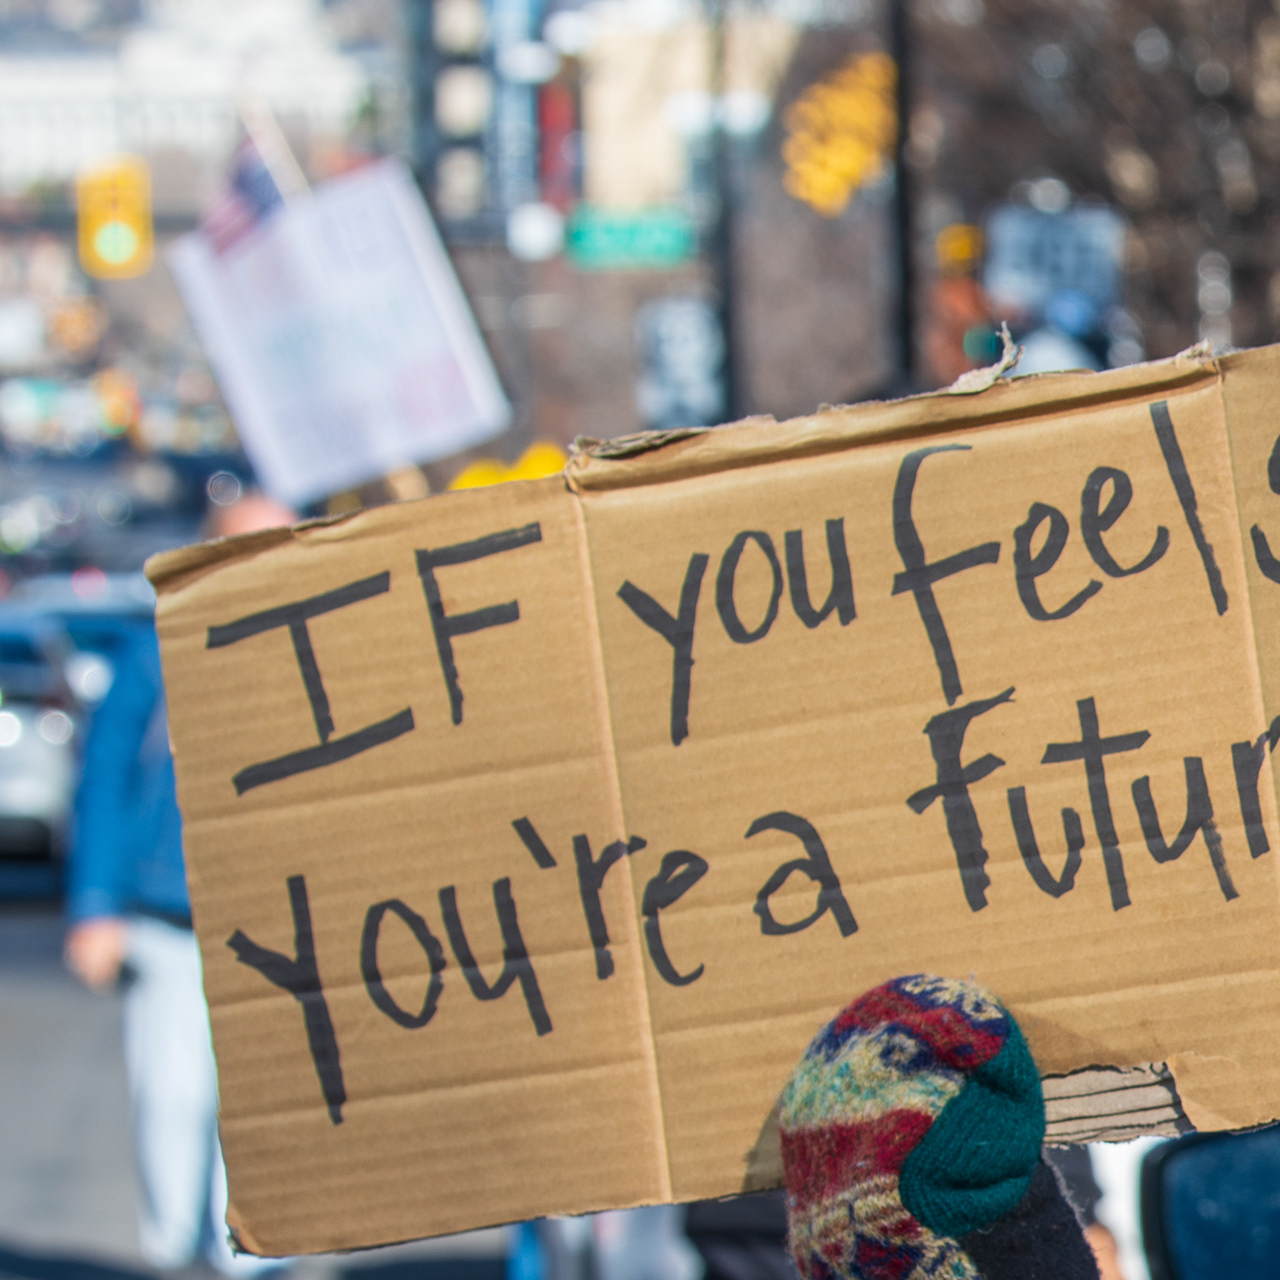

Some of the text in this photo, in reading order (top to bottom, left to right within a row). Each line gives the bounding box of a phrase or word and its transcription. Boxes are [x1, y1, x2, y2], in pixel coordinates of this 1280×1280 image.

[206, 522, 543, 796] IF
[617, 517, 858, 747] you
[891, 400, 1228, 705] feel
[745, 811, 859, 938] a
